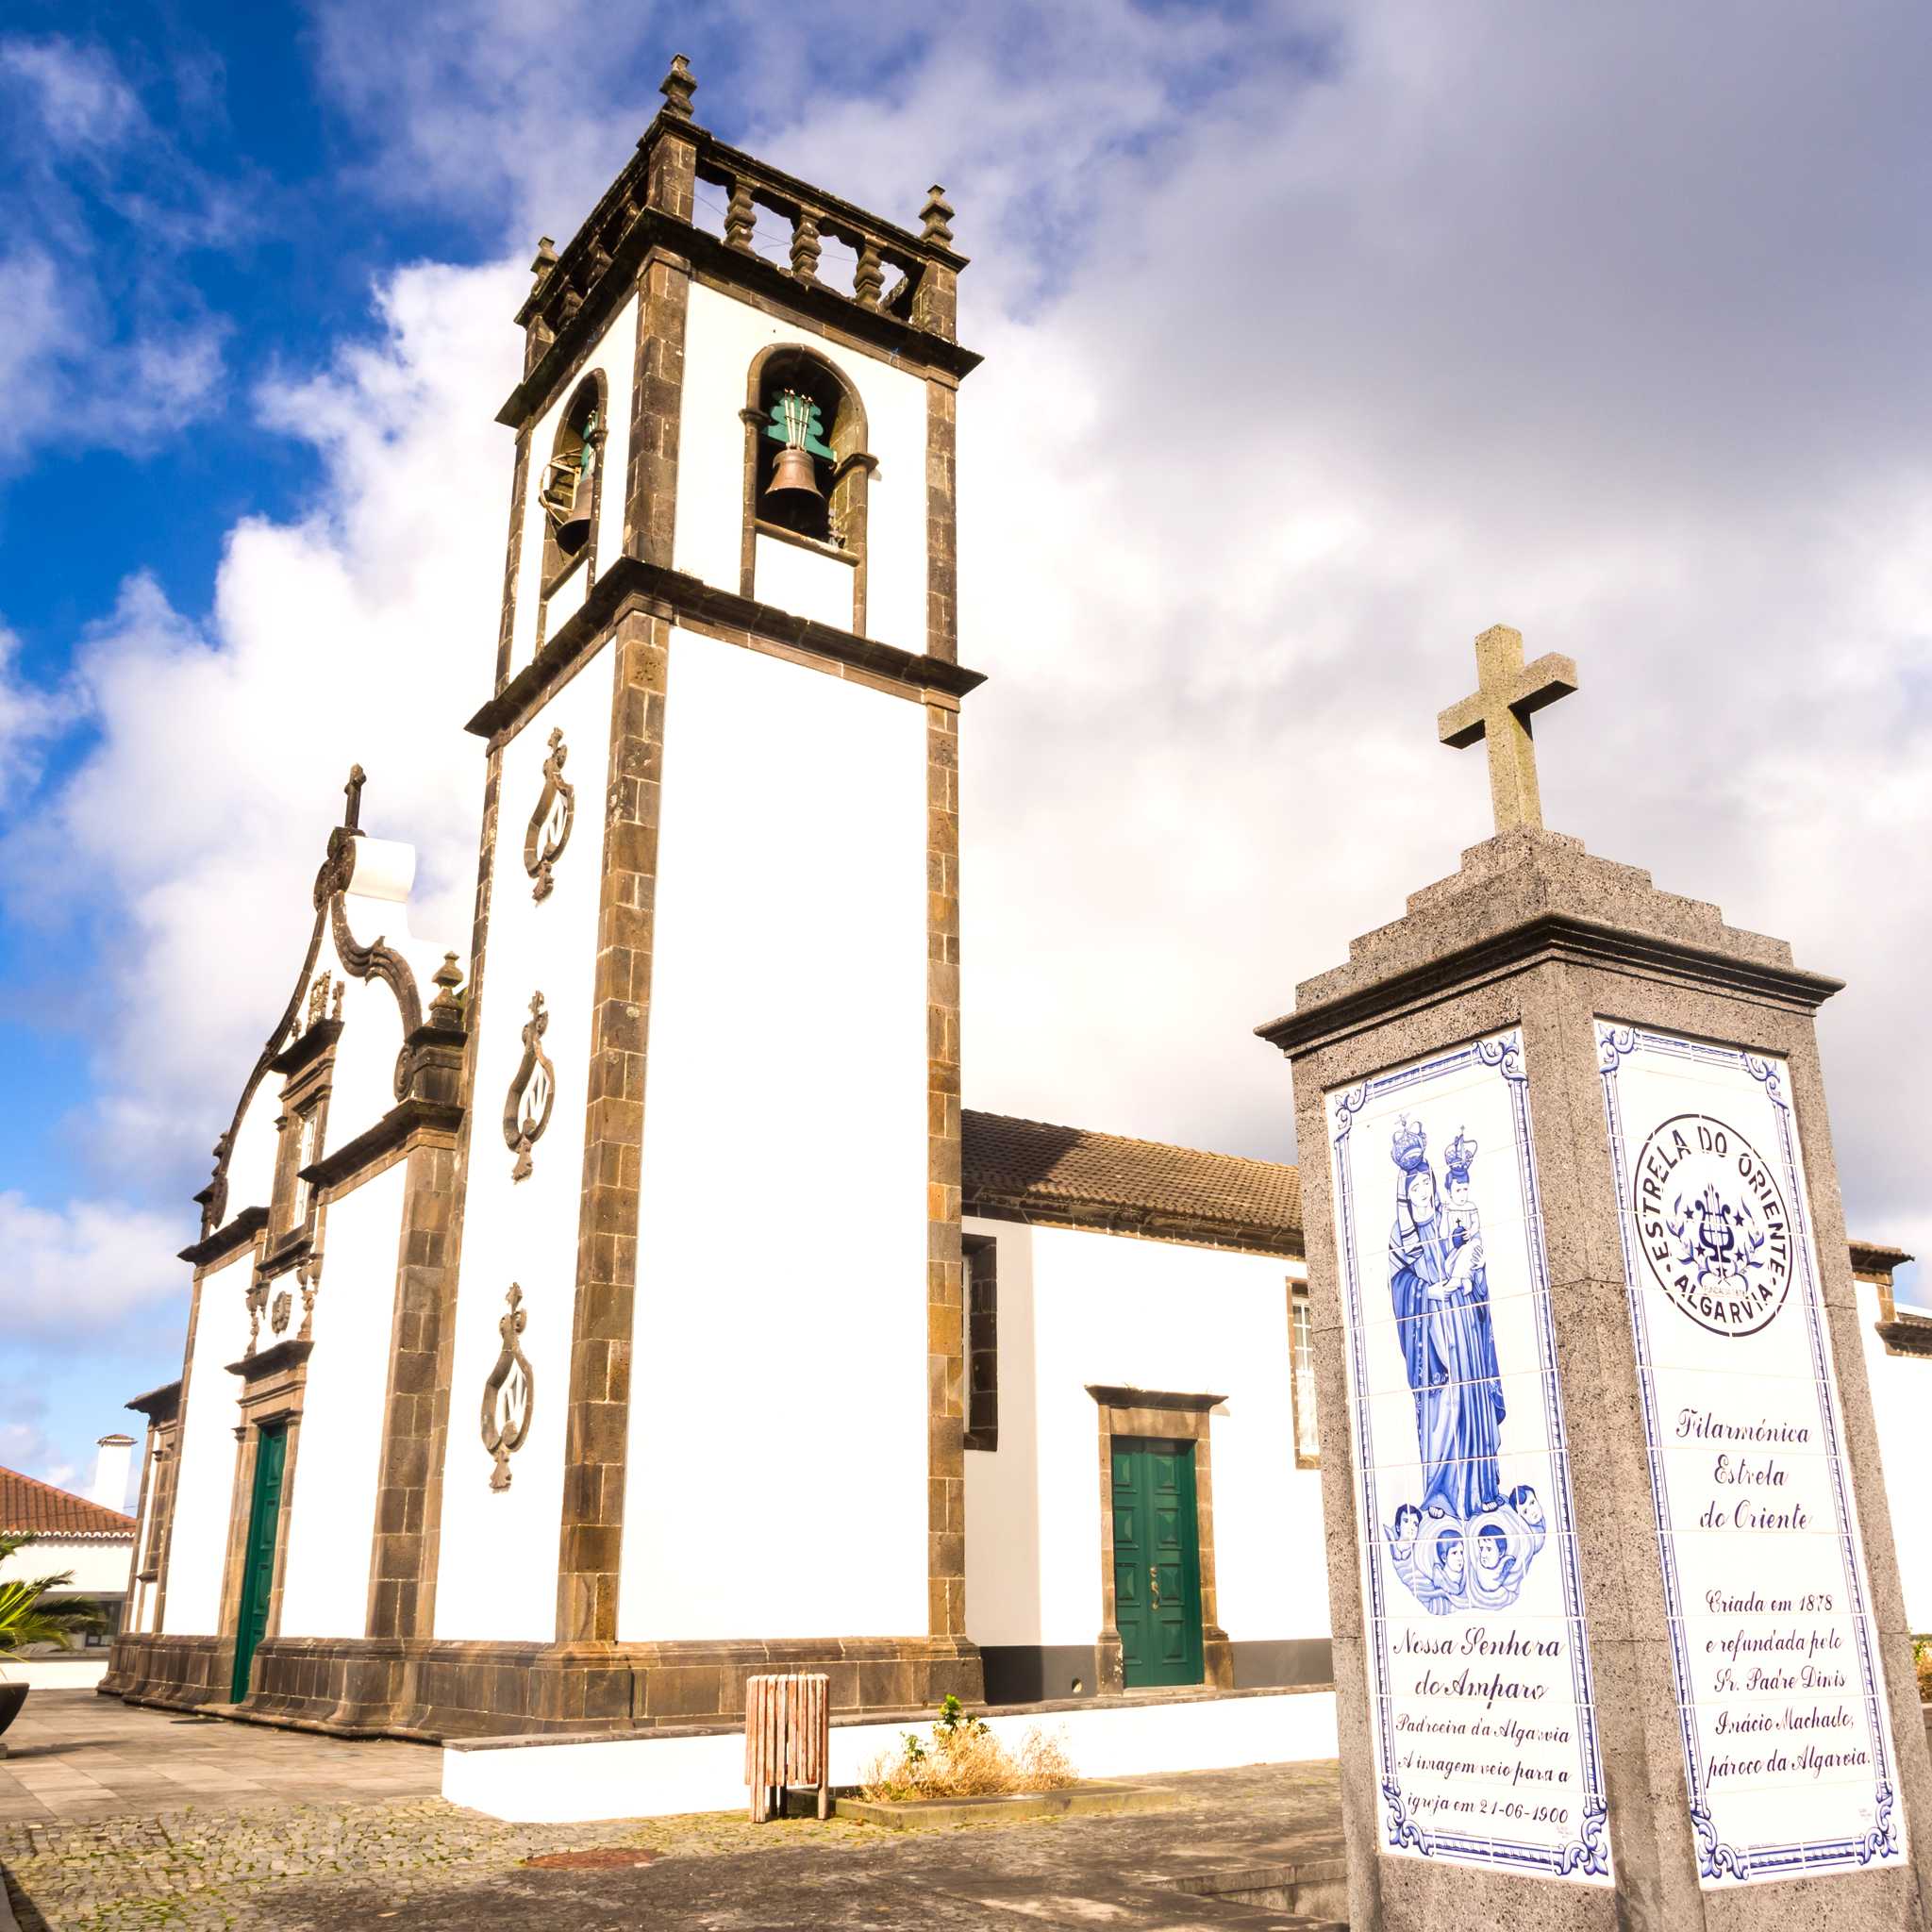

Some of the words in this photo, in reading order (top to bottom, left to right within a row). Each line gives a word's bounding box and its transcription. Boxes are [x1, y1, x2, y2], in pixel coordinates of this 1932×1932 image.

[1642, 1129, 1692, 1261] ESTRELA
[1697, 1125, 1727, 1158] DO
[1738, 1153, 1787, 1277] ORIENTE
[1676, 1408, 1807, 1442] Filarmónica
[1714, 1454, 1788, 1486] Estrela
[1700, 1501, 1725, 1528] do
[1735, 1500, 1811, 1529] Oriente
[1706, 1590, 1765, 1612] Criada
[1771, 1600, 1791, 1611] em
[1393, 1628, 1453, 1655] Nossa
[1461, 1627, 1563, 1657] Senhora
[1707, 1641, 1714, 1653] e
[1722, 1629, 1805, 1661] refundada
[1808, 1628, 1840, 1658] pelo
[1415, 1670, 1442, 1695] do
[1445, 1668, 1548, 1709] Amparo
[1746, 1668, 1798, 1690] Padre
[1801, 1665, 1845, 1688] Dinis
[1396, 1714, 1466, 1734] Padroeira
[1472, 1718, 1491, 1736] da
[1715, 1711, 1773, 1735] Inácio
[1398, 1751, 1413, 1768] A
[1417, 1756, 1474, 1779] imagem
[1481, 1762, 1510, 1776] veio
[1512, 1761, 1553, 1786] para
[1558, 1772, 1570, 1782] a
[1706, 1756, 1762, 1789] pároco
[1767, 1749, 1788, 1772] da
[1407, 1792, 1449, 1815] igreja
[1454, 1801, 1474, 1812] em
[1480, 1800, 1568, 1824] 21-06-1900
